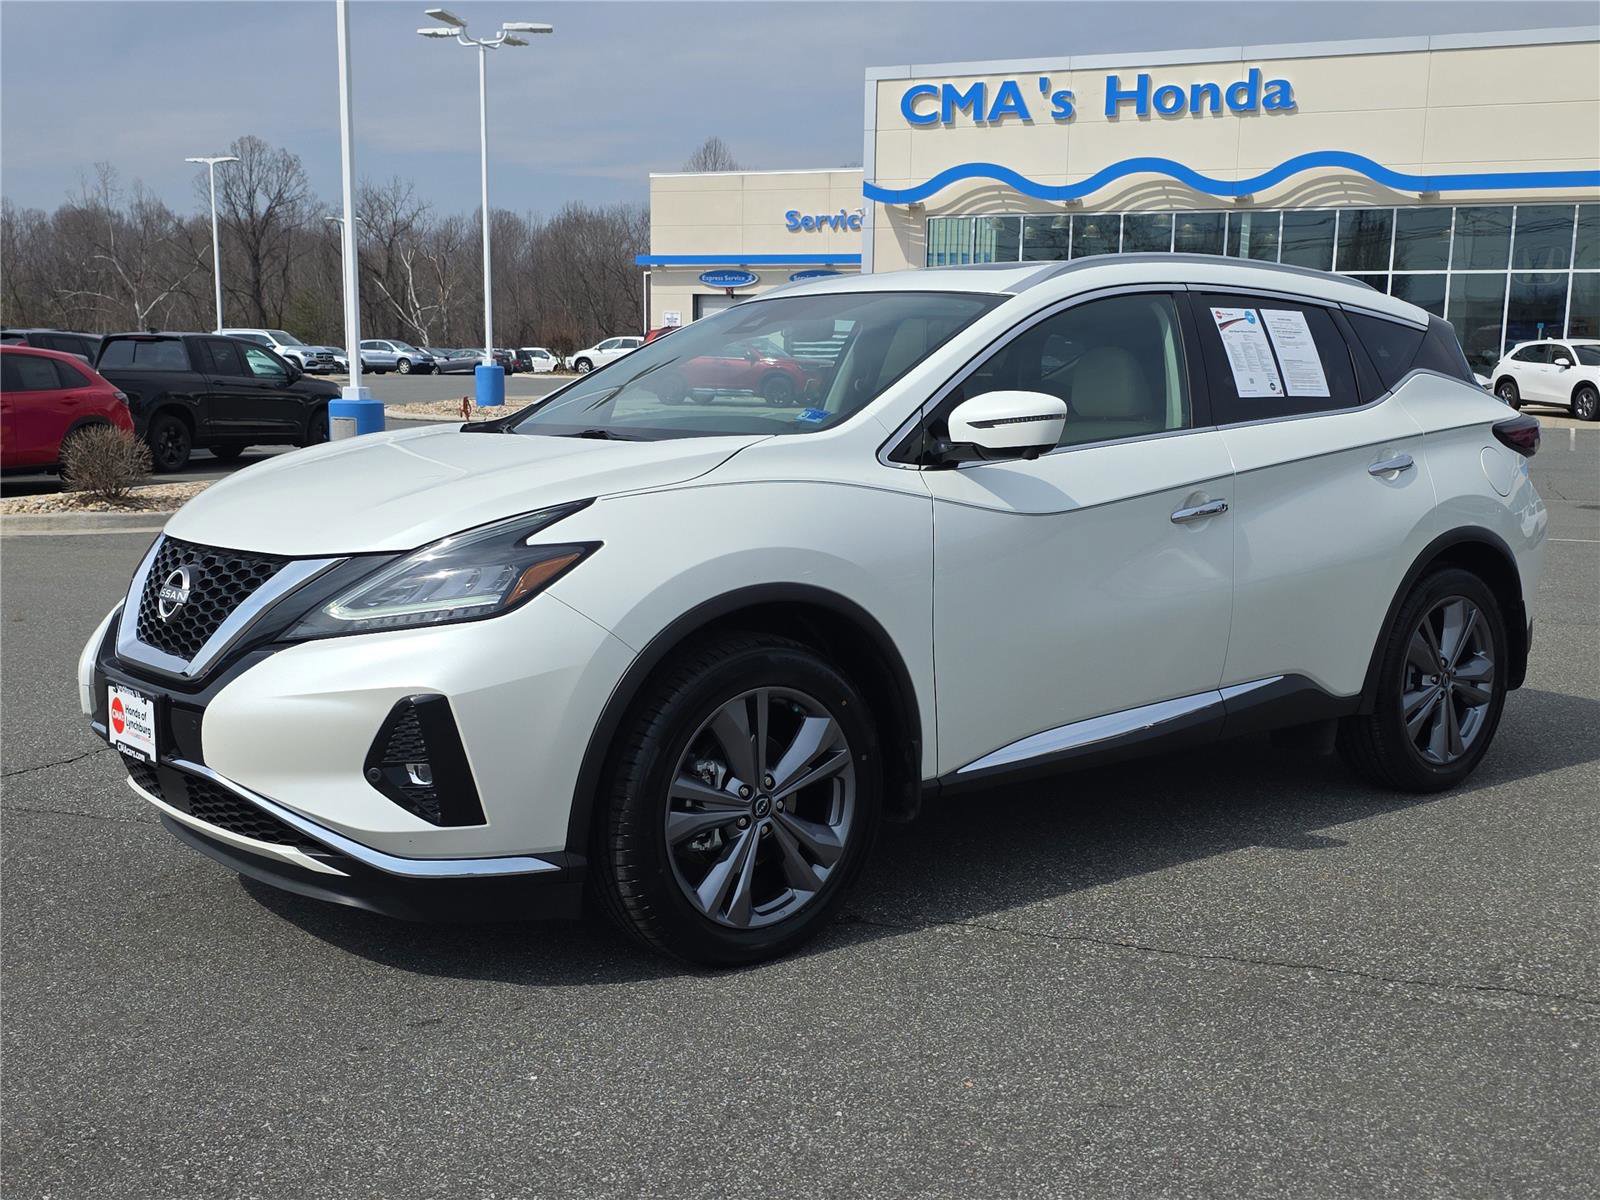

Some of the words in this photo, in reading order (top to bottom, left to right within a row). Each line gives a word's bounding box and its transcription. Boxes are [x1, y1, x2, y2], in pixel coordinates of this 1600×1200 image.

[900, 75, 1076, 125] CMA's
[1104, 67, 1298, 118] Honda
[785, 209, 864, 231] Servic
[701, 274, 723, 282] Express
[125, 704, 141, 720] Honda
[141, 711, 147, 721] of
[126, 716, 152, 738] Lynchburg
